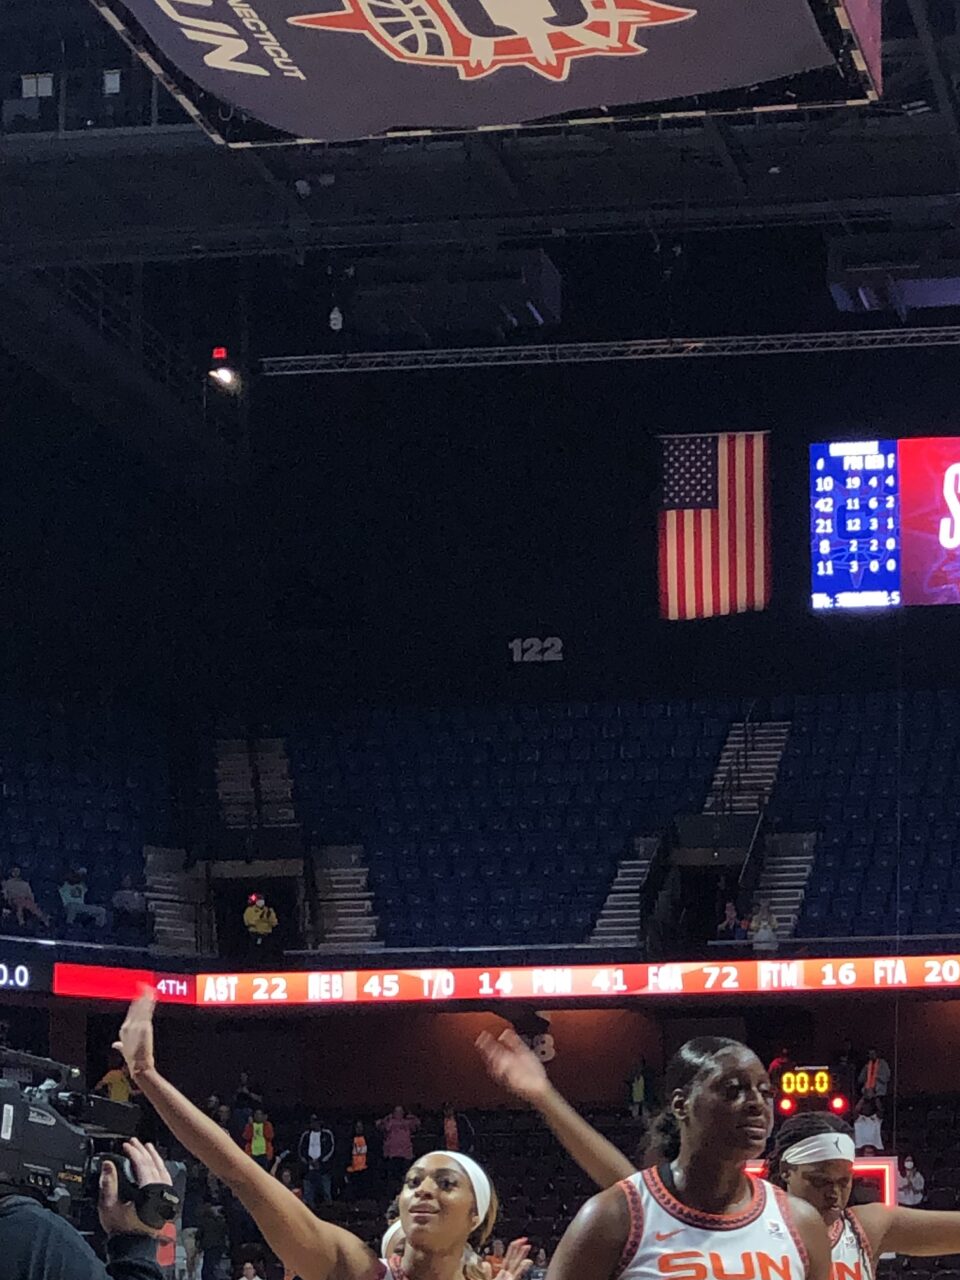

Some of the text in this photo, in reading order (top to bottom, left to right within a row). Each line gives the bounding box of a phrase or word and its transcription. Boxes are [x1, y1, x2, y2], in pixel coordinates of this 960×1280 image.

[508, 637, 563, 662] 122
[156, 979, 188, 996] 4TH
[203, 976, 237, 1001] AST
[252, 978, 288, 1000] 22
[363, 974, 399, 997] 45
[478, 971, 512, 994] 14
[592, 969, 627, 991] 41
[703, 966, 739, 988] 72
[821, 963, 856, 985] 16
[873, 960, 907, 984] FTA
[924, 960, 960, 983] 20
[782, 1071, 828, 1093] 00.0
